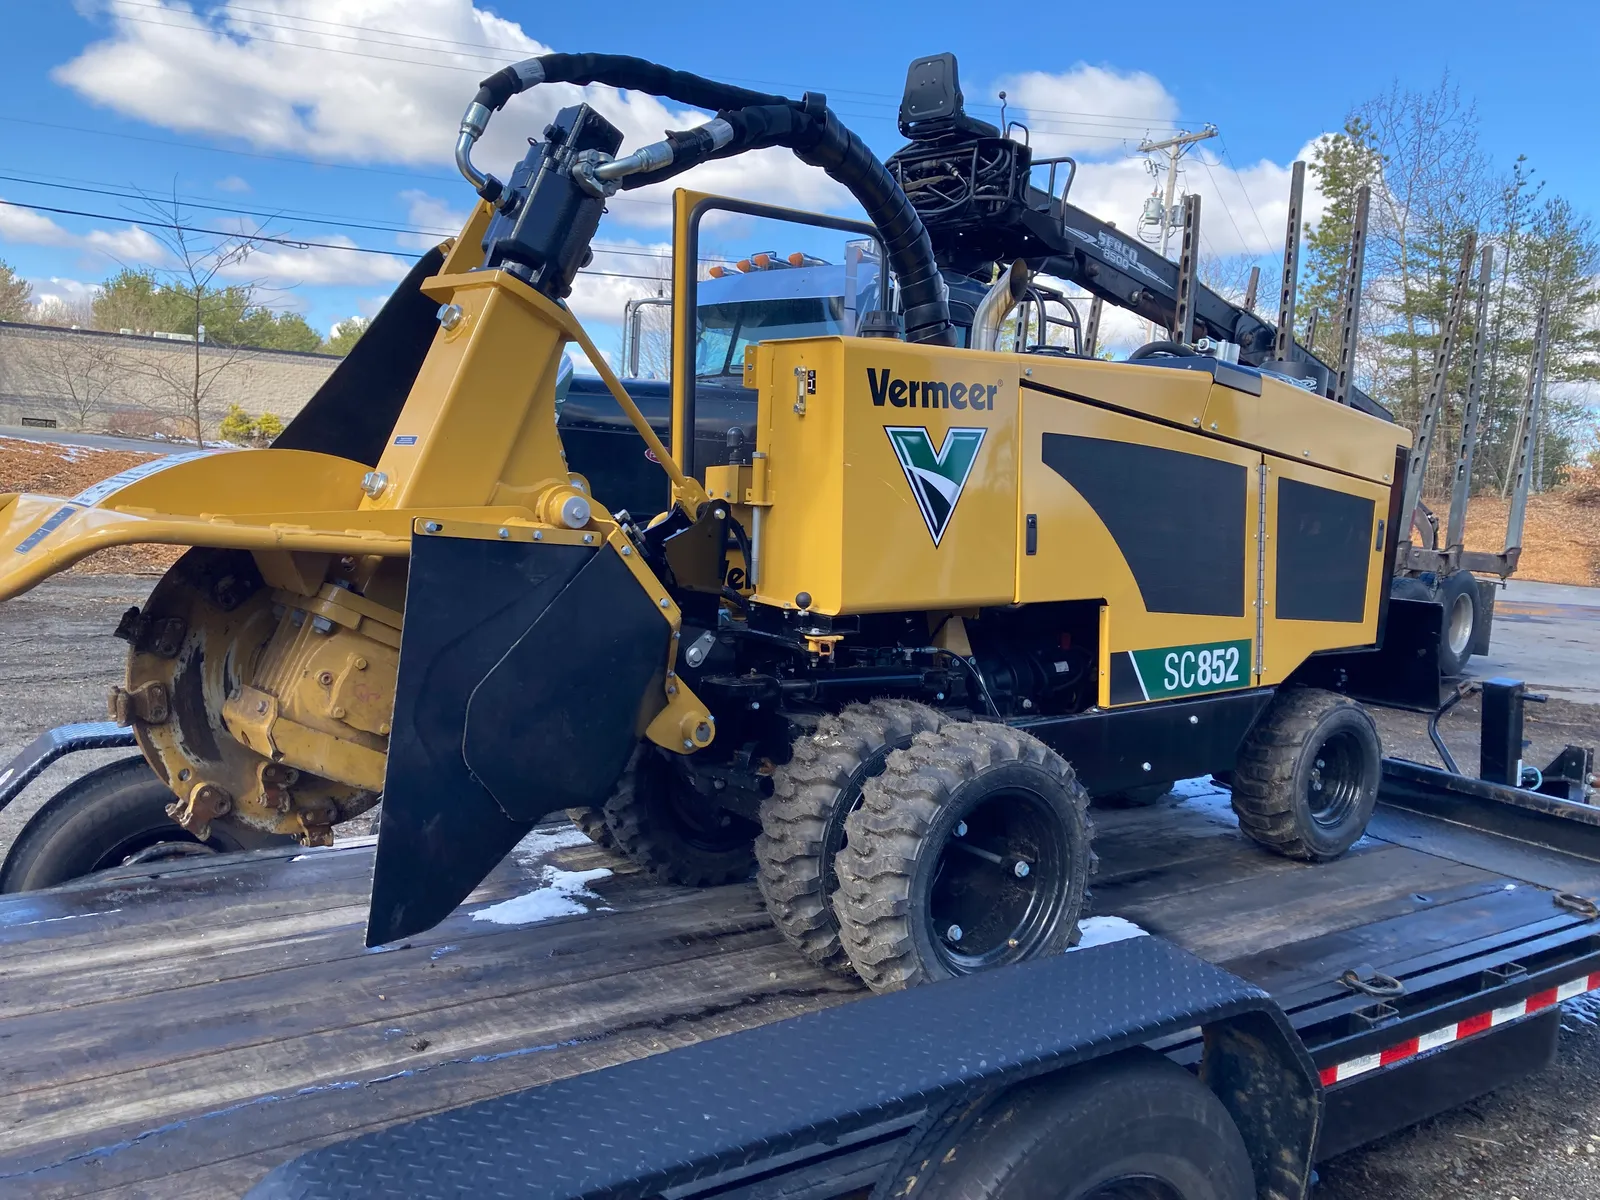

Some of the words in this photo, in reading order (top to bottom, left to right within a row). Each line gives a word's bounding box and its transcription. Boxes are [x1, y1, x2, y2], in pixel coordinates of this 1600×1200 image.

[1098, 230, 1139, 265] SERCO
[1103, 247, 1130, 271] 8500
[866, 367, 998, 411] Vermeer
[1164, 646, 1240, 691] SC852
